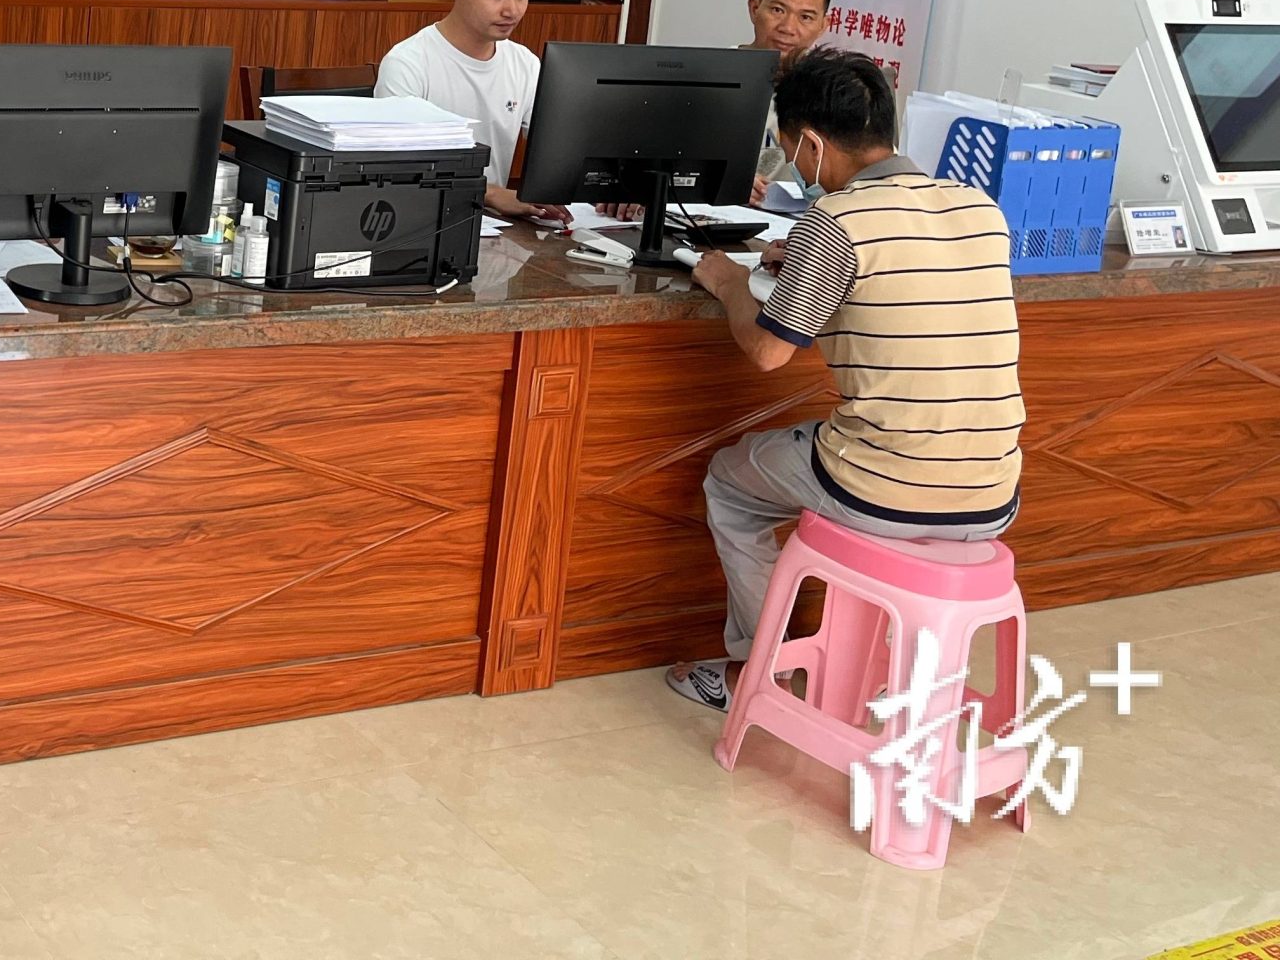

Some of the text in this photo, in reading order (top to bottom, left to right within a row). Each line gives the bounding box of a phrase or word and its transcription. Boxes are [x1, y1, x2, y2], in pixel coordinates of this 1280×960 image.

[829, 7, 906, 47] 科学唯物论
[362, 200, 394, 241] hp
